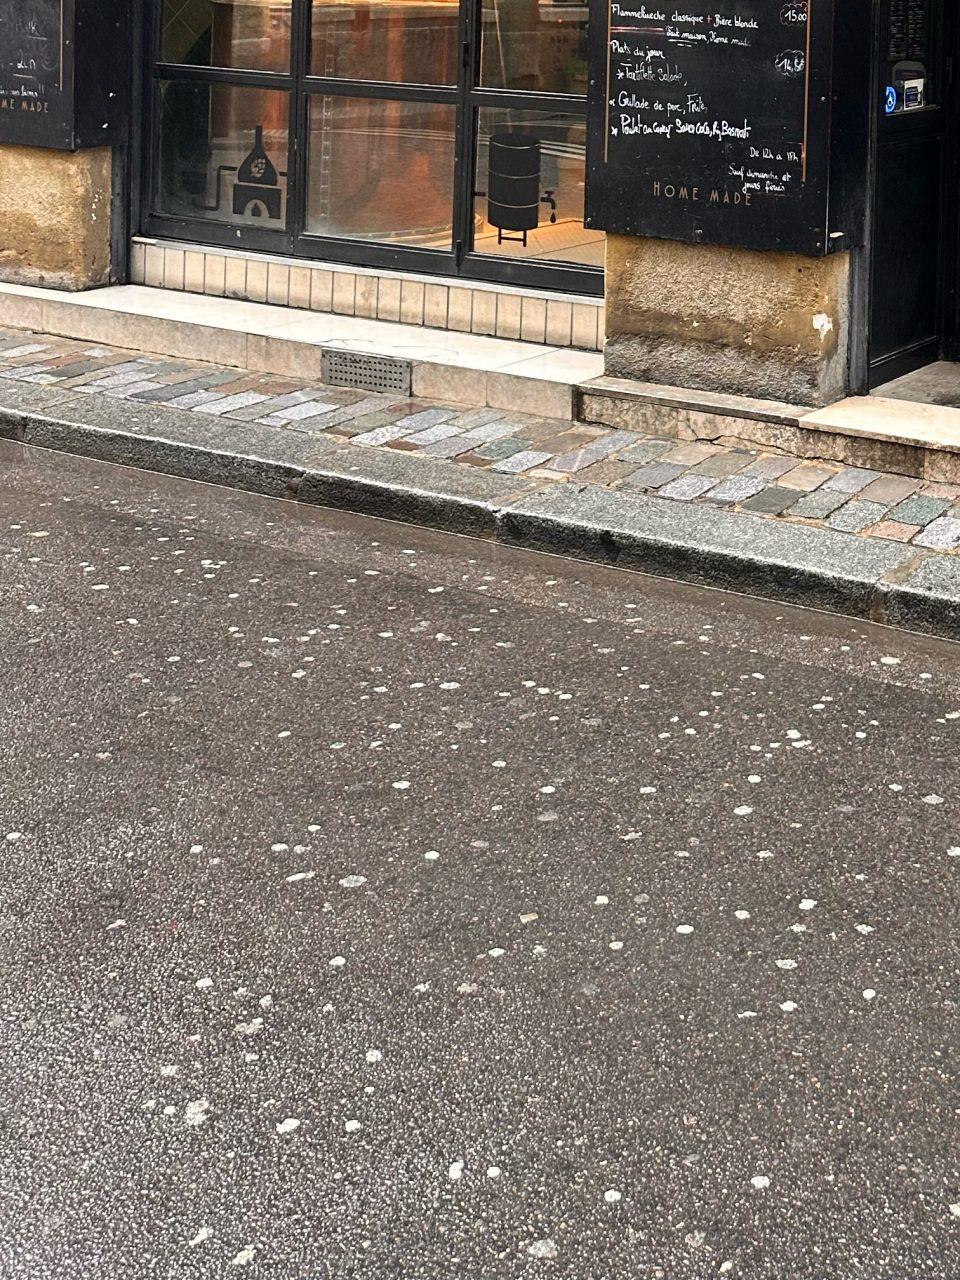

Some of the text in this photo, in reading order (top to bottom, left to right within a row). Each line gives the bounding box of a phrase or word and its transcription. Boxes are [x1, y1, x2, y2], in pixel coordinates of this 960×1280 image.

[671, 10, 704, 26] classique
[734, 15, 759, 29] blonde
[633, 47, 645, 57] du
[645, 45, 665, 63] jour
[653, 100, 664, 110] de
[653, 181, 751, 206] HOME MADE
